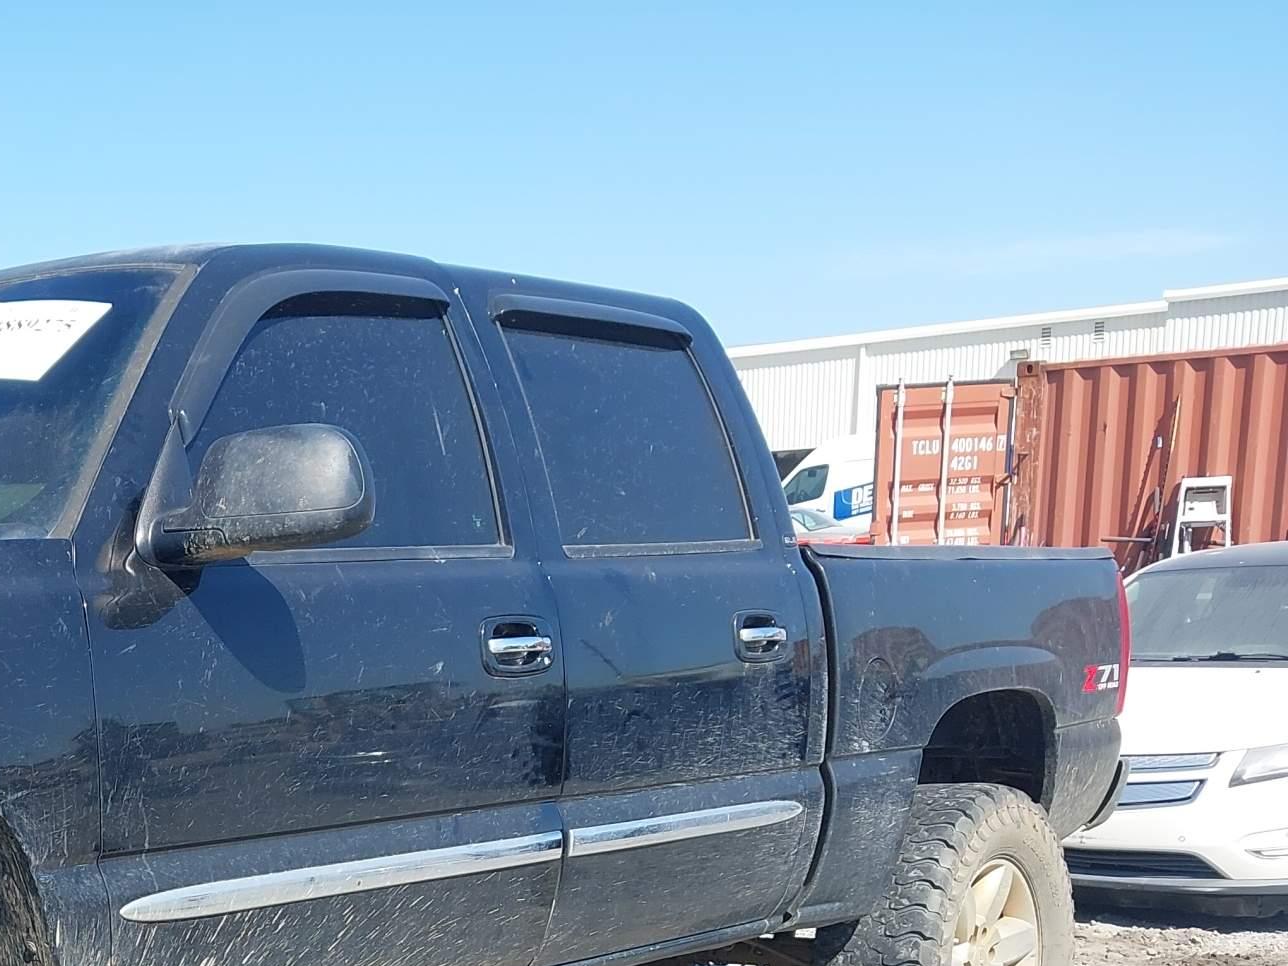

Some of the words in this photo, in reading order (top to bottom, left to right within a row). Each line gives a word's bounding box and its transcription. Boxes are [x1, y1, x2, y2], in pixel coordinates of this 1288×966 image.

[912, 440, 940, 456] TCLU
[952, 436, 993, 453] 400146
[951, 456, 978, 470] 42G1
[1082, 664, 1120, 693] Z71
